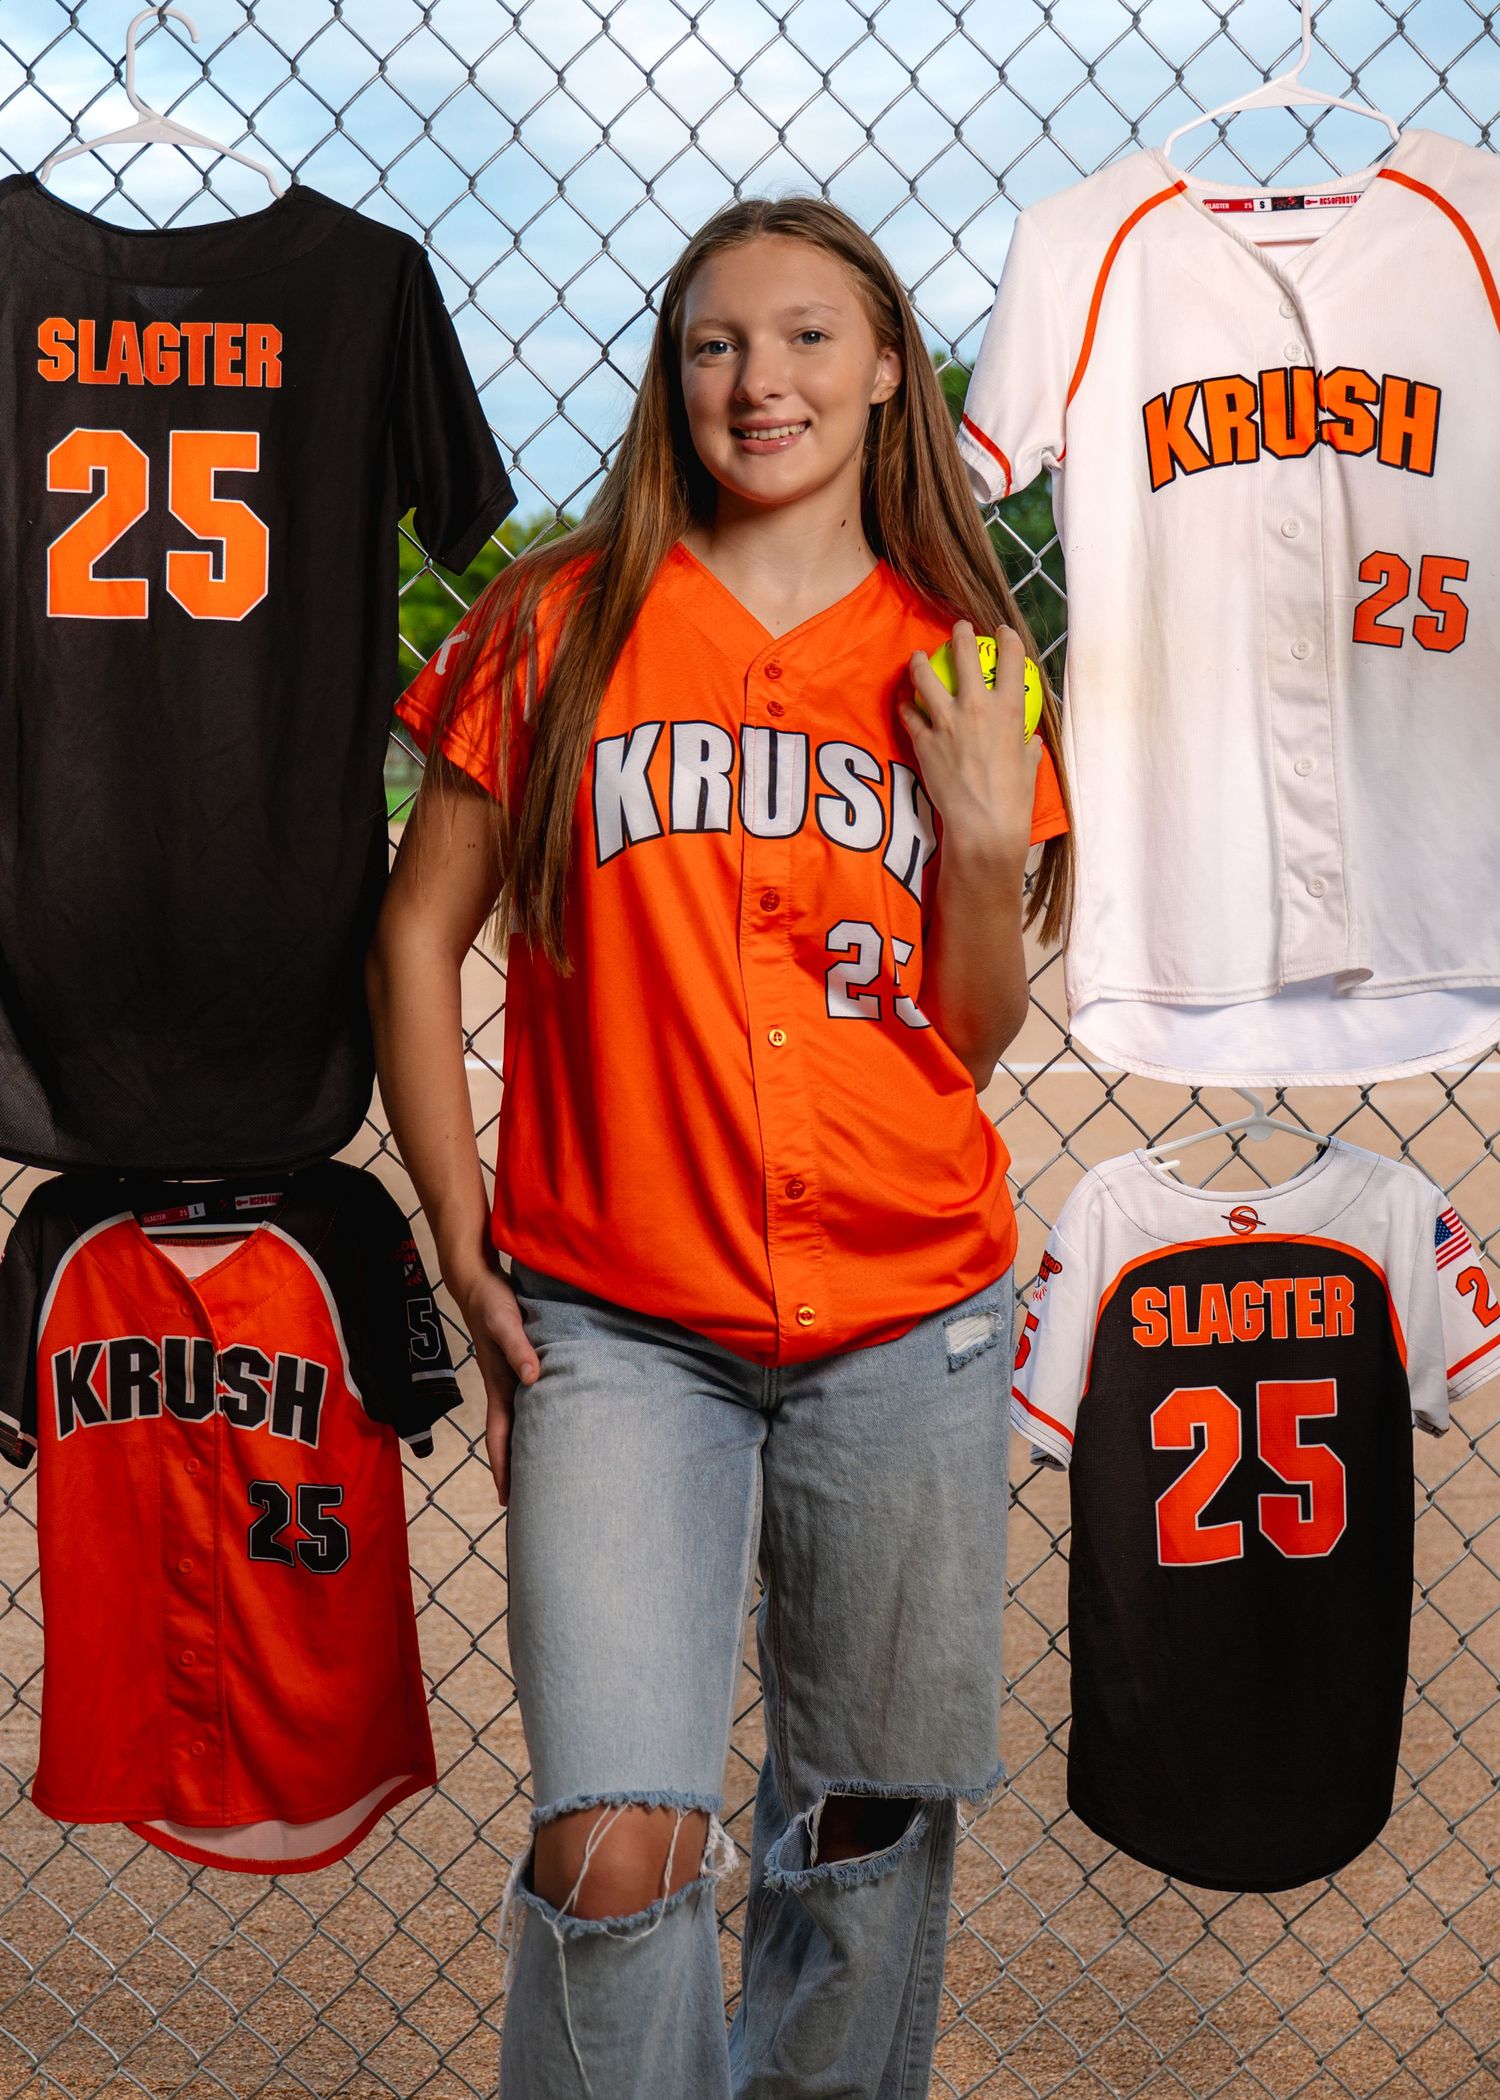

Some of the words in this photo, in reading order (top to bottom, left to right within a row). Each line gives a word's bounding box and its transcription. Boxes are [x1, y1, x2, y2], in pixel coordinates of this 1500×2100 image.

[1259, 201, 1266, 209] S
[37, 317, 283, 388] SLAGTER
[1142, 366, 1442, 492] KRUSH
[46, 427, 270, 621] 25
[1353, 550, 1469, 653] 25
[595, 720, 937, 905] KRUSH
[179, 1209, 188, 1217] 25
[1131, 1275, 1356, 1348] SLAGTER
[50, 1335, 329, 1450] KRUSH
[1150, 1378, 1348, 1567] 25
[247, 1480, 351, 1575] 25
